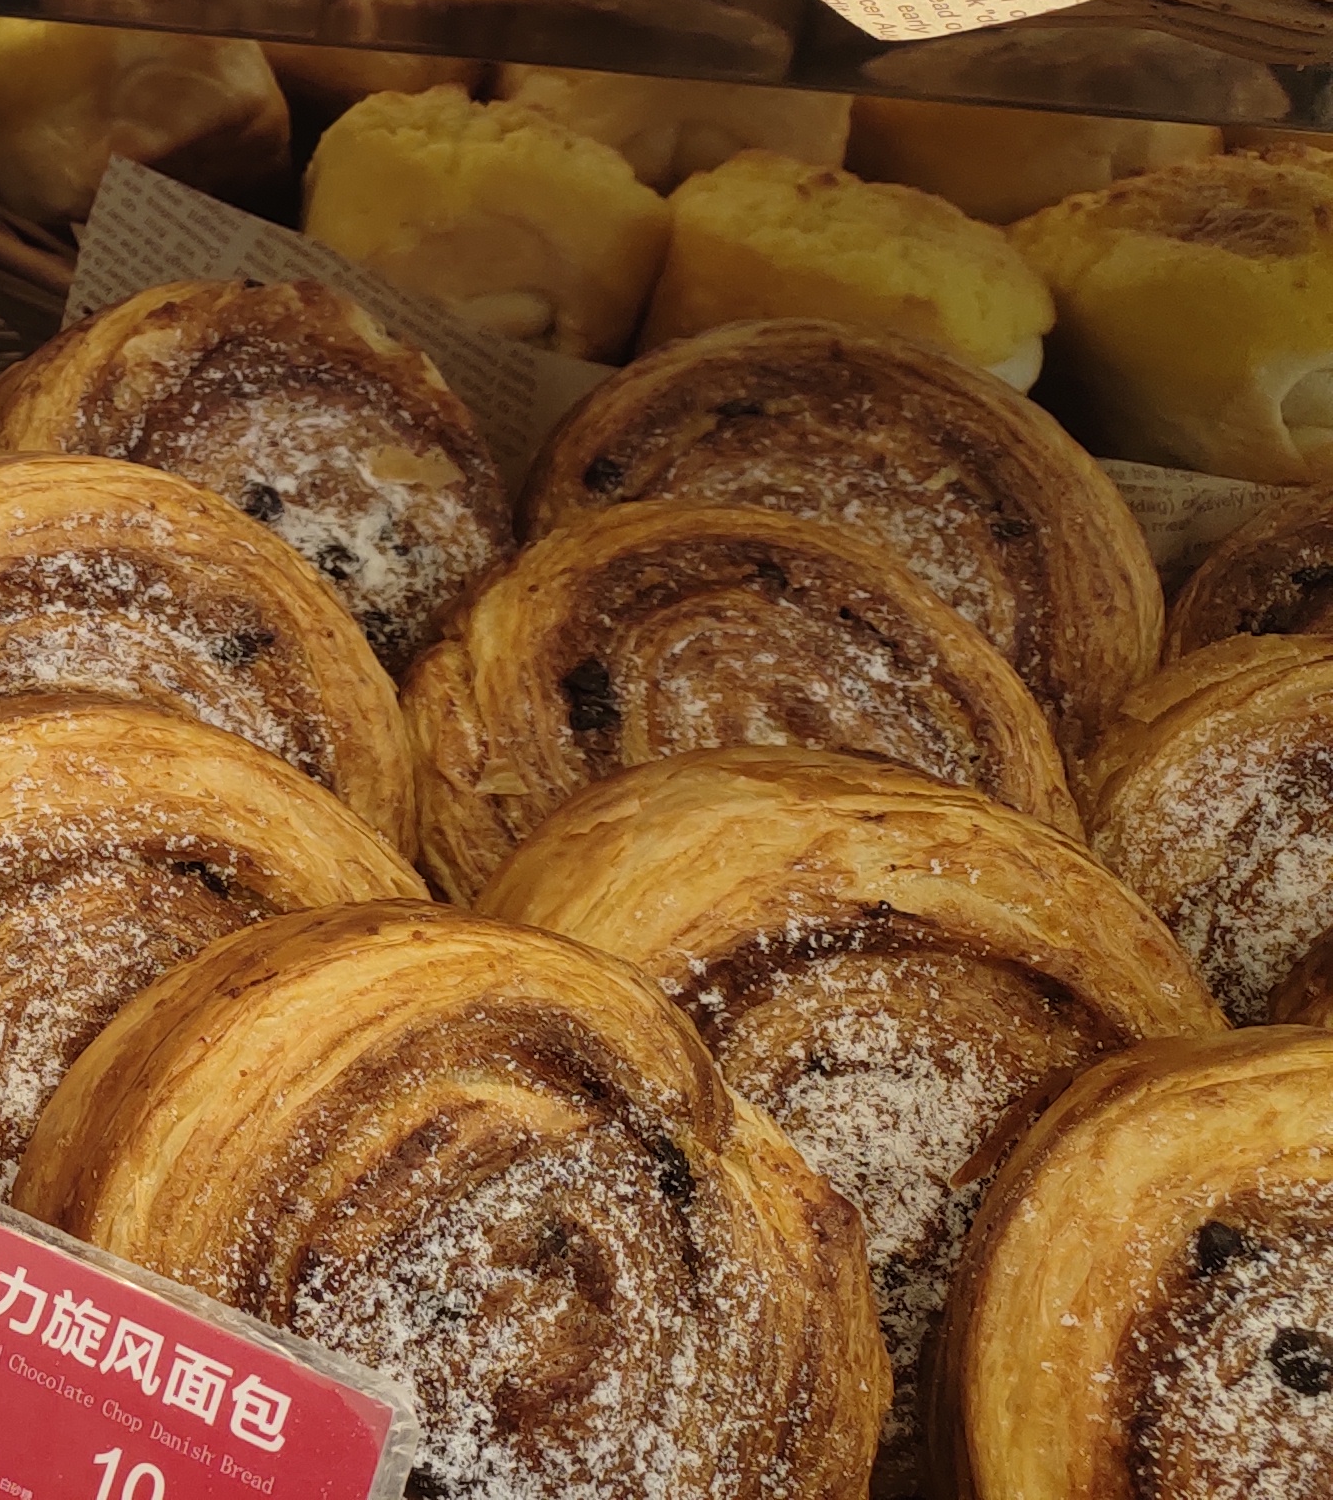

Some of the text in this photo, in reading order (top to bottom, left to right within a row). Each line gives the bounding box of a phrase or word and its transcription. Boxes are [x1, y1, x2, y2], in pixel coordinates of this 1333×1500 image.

[897, 4, 932, 34] early
[8, 1354, 96, 1409] Chocolate
[101, 1399, 144, 1433] Chop
[148, 1420, 215, 1468] Danish
[219, 1452, 277, 1497] Bread
[92, 1446, 167, 1500] 10
